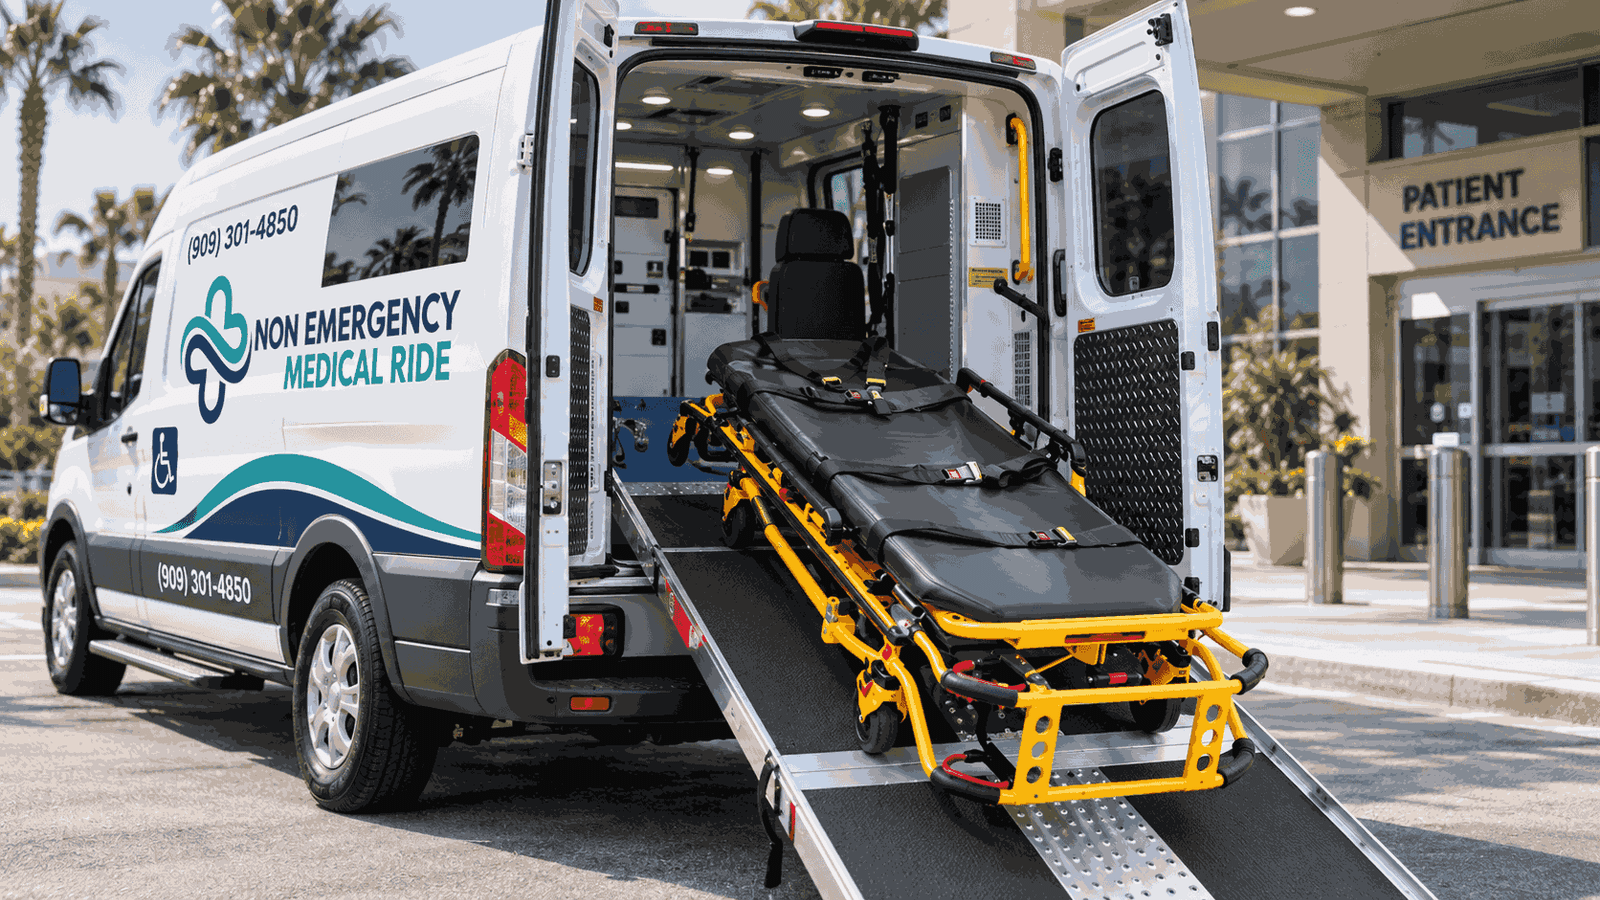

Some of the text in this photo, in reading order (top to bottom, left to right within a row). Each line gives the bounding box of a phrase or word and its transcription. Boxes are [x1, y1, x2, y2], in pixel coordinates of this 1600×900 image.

[1403, 167, 1525, 213] PATIENT
[187, 205, 299, 265] (909) 301-4850
[1401, 202, 1560, 250] ENTRANCE
[254, 290, 461, 351] NON EMERGENCY
[284, 341, 452, 390] MEDICAL RIDE
[157, 562, 251, 604] (909) 301-4850
